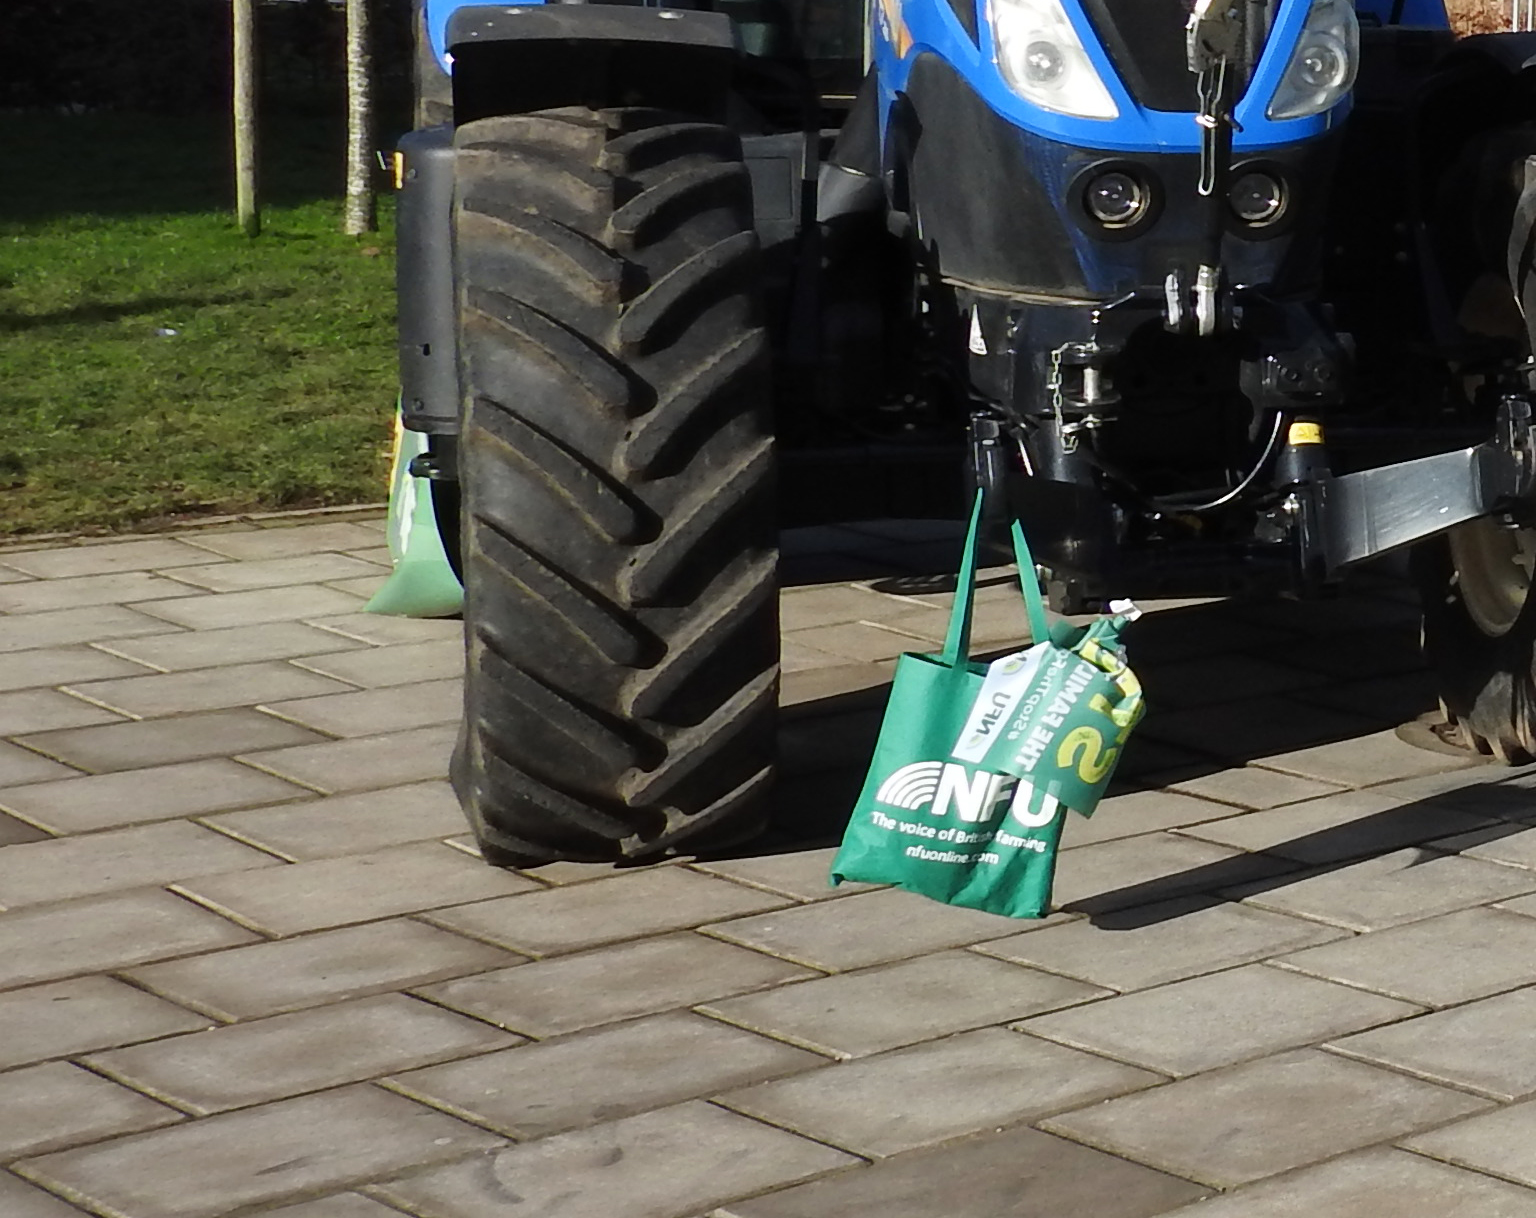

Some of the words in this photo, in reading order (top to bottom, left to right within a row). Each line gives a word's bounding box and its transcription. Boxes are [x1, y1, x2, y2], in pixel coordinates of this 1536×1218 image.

[871, 810, 897, 830] The
[899, 821, 936, 838] voice
[938, 828, 956, 842] of
[995, 829, 1048, 853] farming
